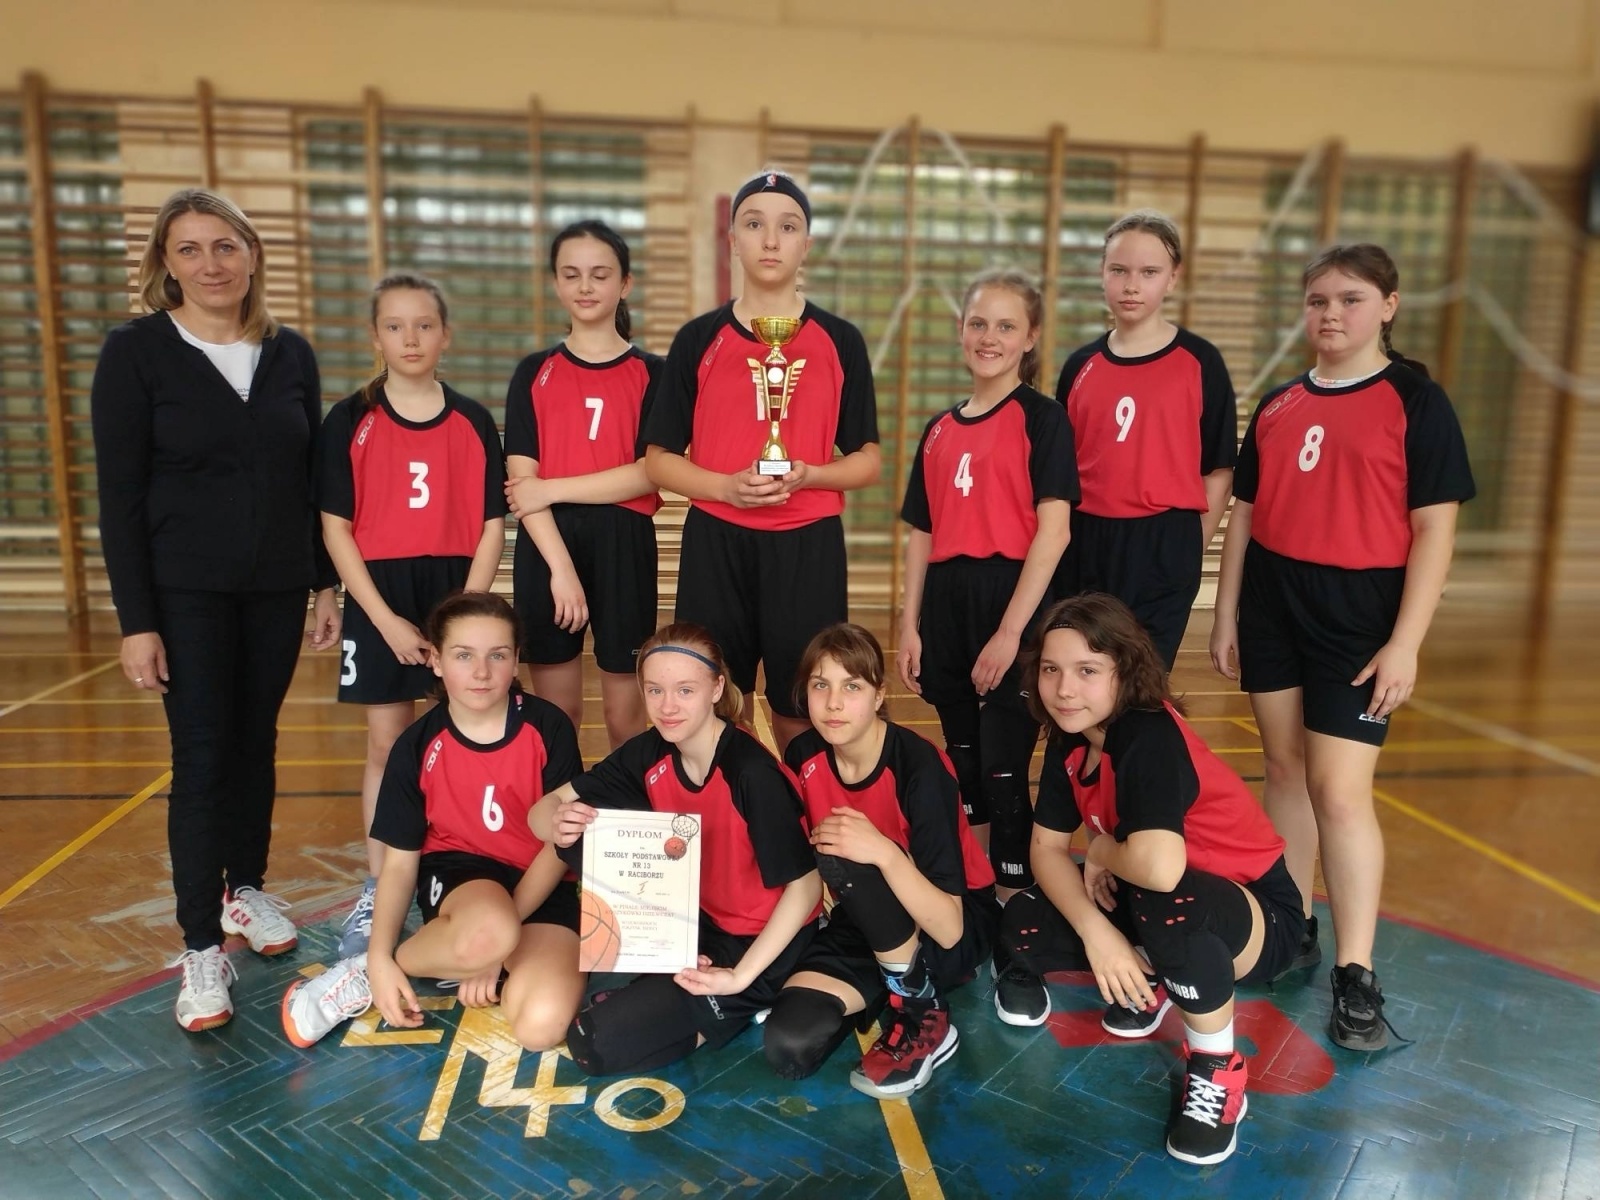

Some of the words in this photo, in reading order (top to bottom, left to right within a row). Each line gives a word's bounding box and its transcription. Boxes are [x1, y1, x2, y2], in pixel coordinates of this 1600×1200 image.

[585, 397, 604, 441] 7
[1115, 396, 1136, 443] 9
[1298, 425, 1325, 472] 8
[409, 461, 430, 509] 3
[954, 452, 974, 498] 4
[340, 639, 358, 687] 3
[482, 784, 505, 833] 6
[962, 803, 974, 816] BA
[617, 829, 663, 839] DYPLOM
[603, 851, 629, 859] SZKOŁY
[632, 861, 641, 869] NR
[643, 862, 651, 870] 13
[1007, 863, 1024, 875] NBA
[430, 875, 444, 907] 6
[1172, 981, 1200, 1000] NBA
